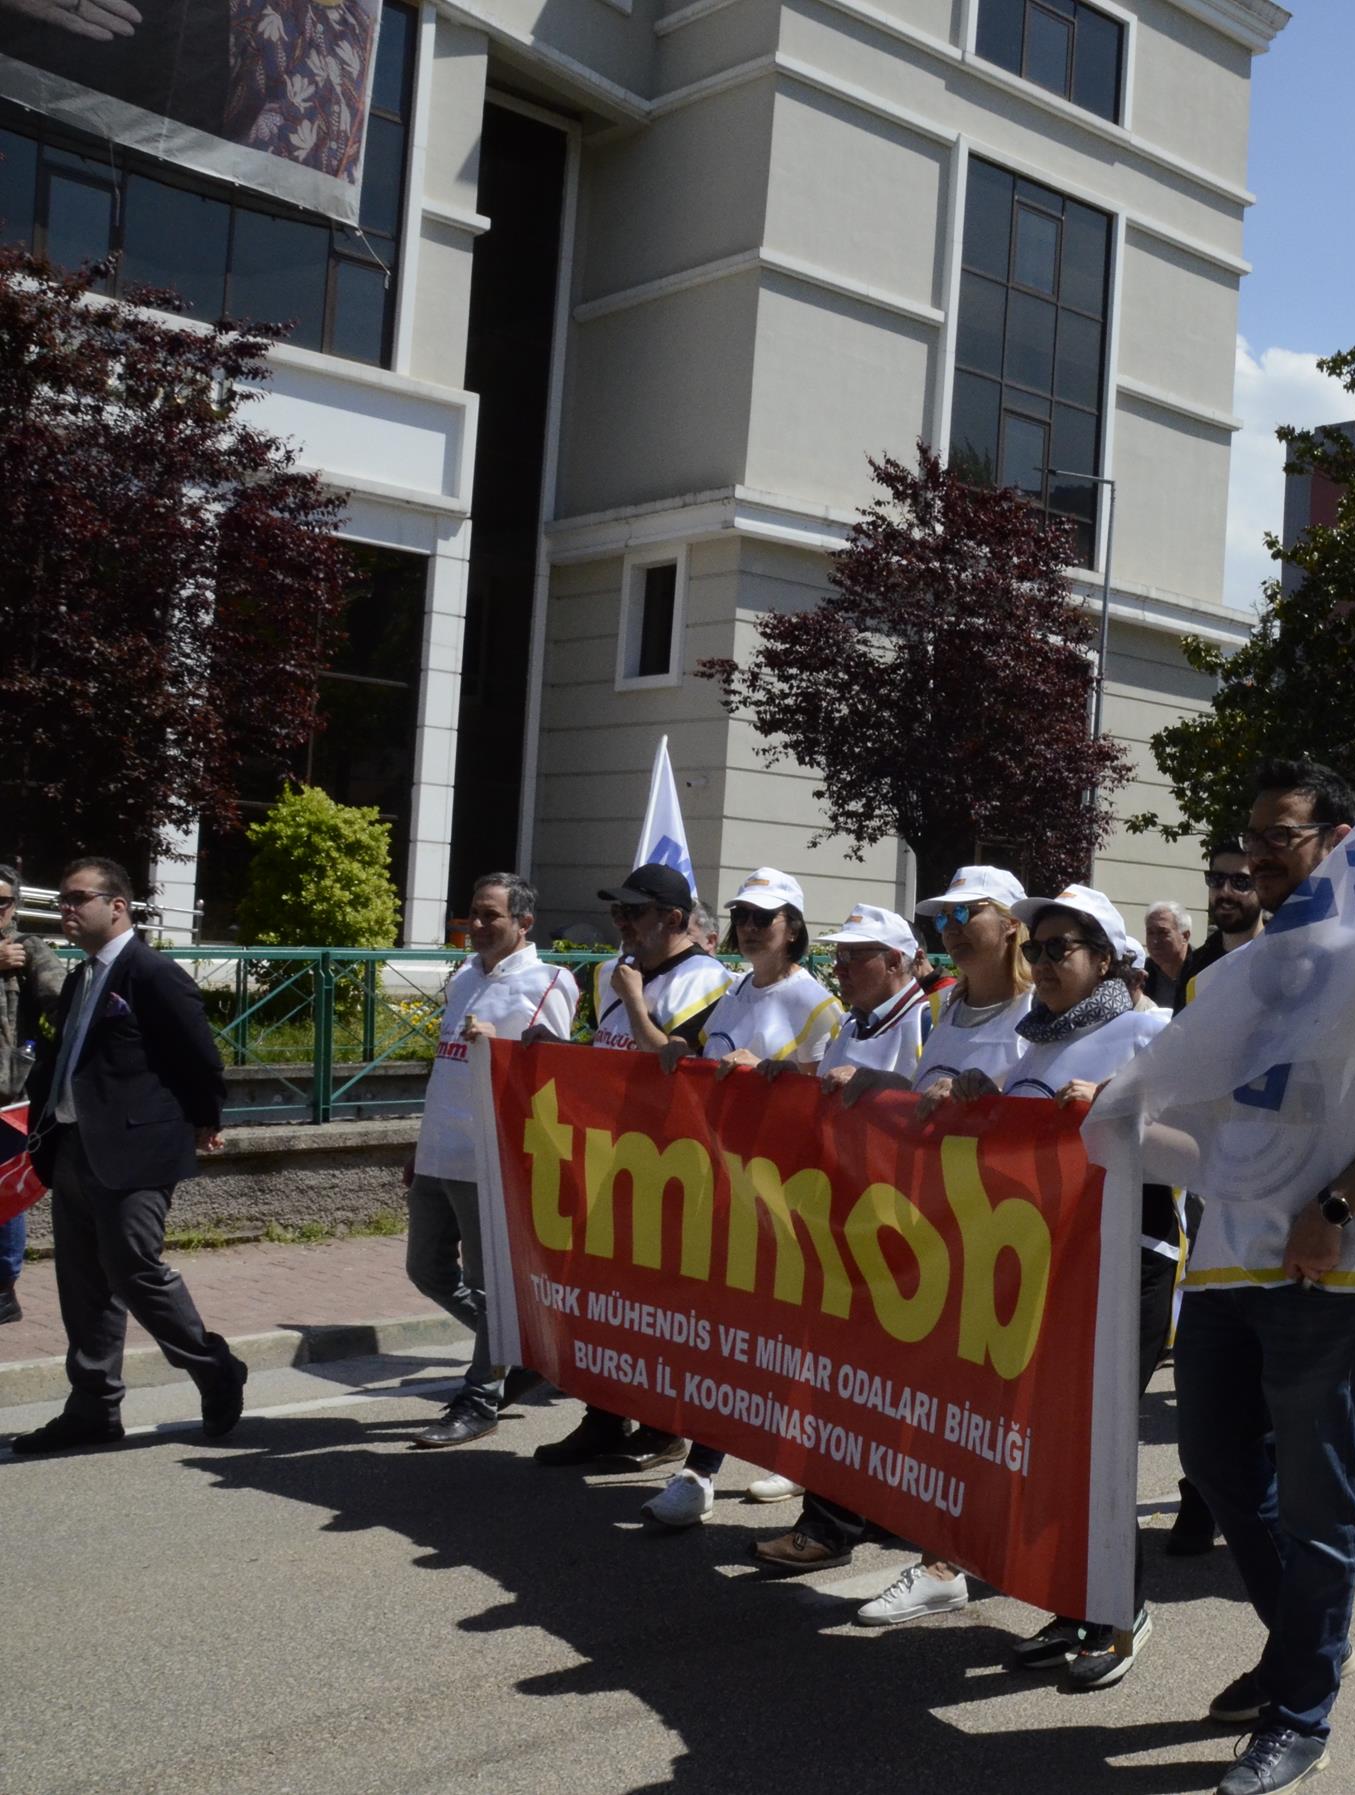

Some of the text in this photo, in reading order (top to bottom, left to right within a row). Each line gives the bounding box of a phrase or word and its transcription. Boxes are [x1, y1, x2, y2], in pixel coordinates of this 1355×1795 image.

[523, 1078, 1052, 1380] tmmob
[530, 1273, 1032, 1477] TÜRK MÜHENDİS VE MİMAR ODALARI BİRLİĞİ
[574, 1339, 966, 1518] BURSA İL KOORDİNASYON KURULU
